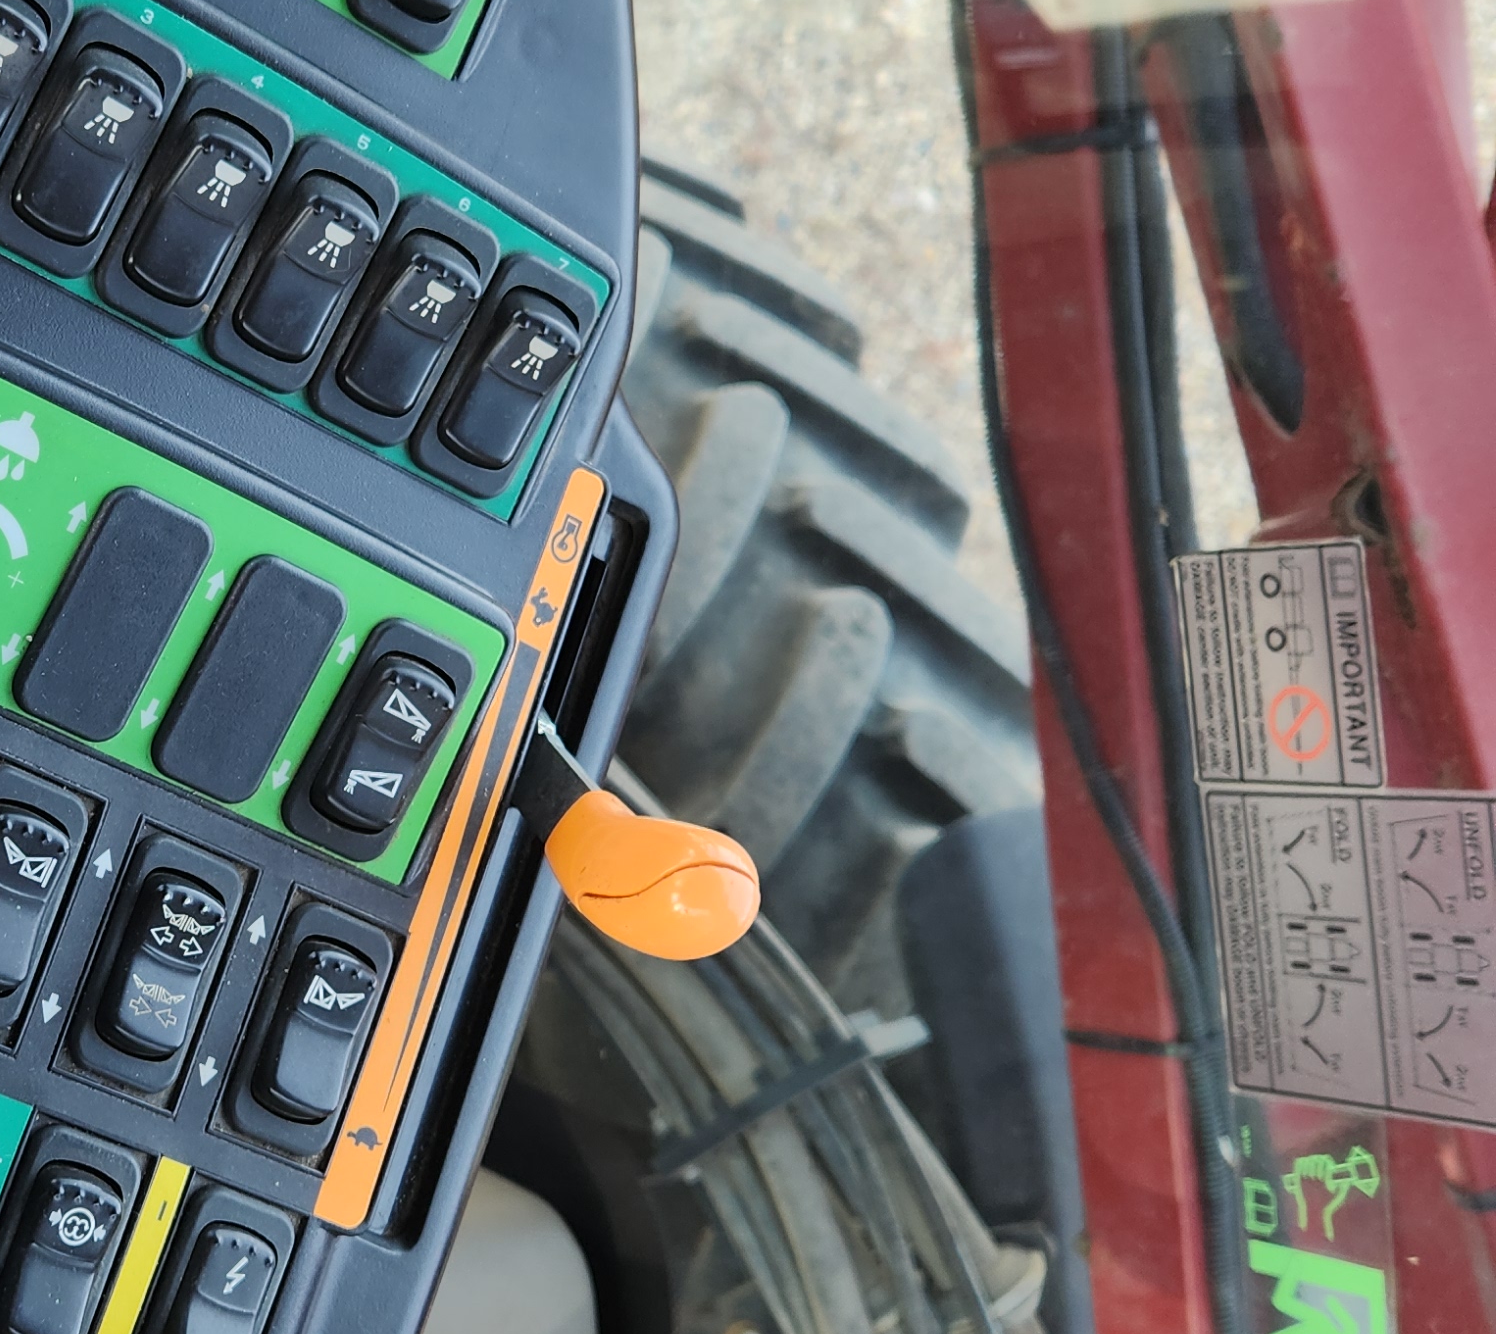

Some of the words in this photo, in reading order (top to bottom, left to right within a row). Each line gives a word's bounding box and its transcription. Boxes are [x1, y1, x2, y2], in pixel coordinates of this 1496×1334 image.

[140, 9, 156, 26] 3
[250, 74, 265, 90] 4
[356, 133, 372, 151] 5
[457, 196, 471, 213] 6
[557, 257, 571, 271] 7
[1335, 611, 1371, 770] IMPORTANT
[1333, 807, 1353, 863] FOLD
[1464, 811, 1487, 901] UNFOLD
